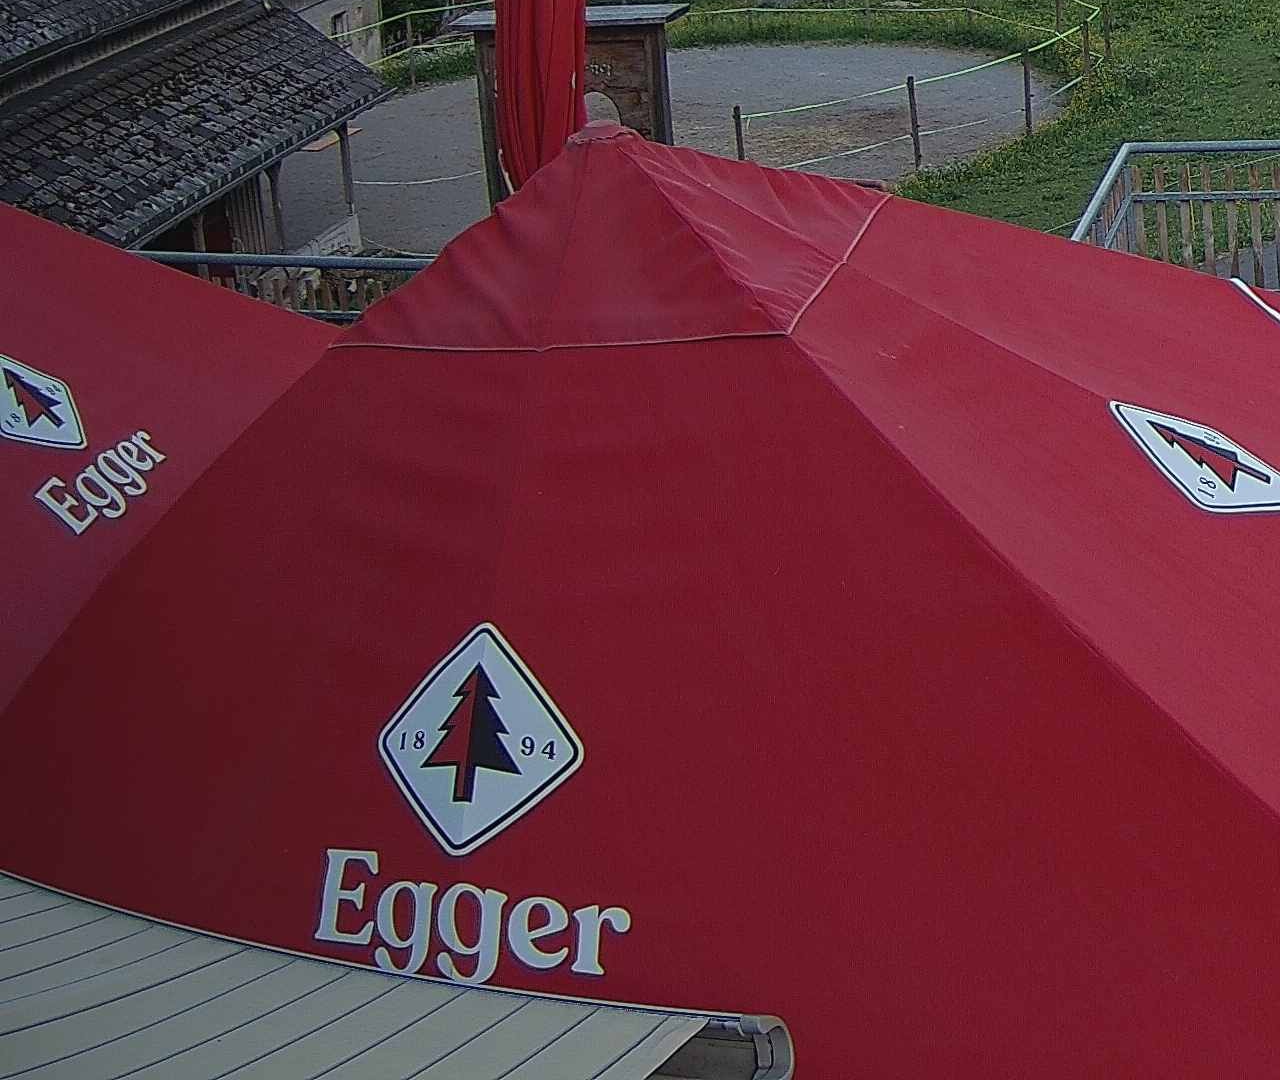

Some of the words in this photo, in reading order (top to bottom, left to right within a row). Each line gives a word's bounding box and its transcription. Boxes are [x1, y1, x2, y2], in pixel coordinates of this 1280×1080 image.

[35, 429, 166, 535] Egger
[398, 730, 426, 752] 18
[520, 736, 557, 760] 94
[314, 847, 632, 985] Egger
